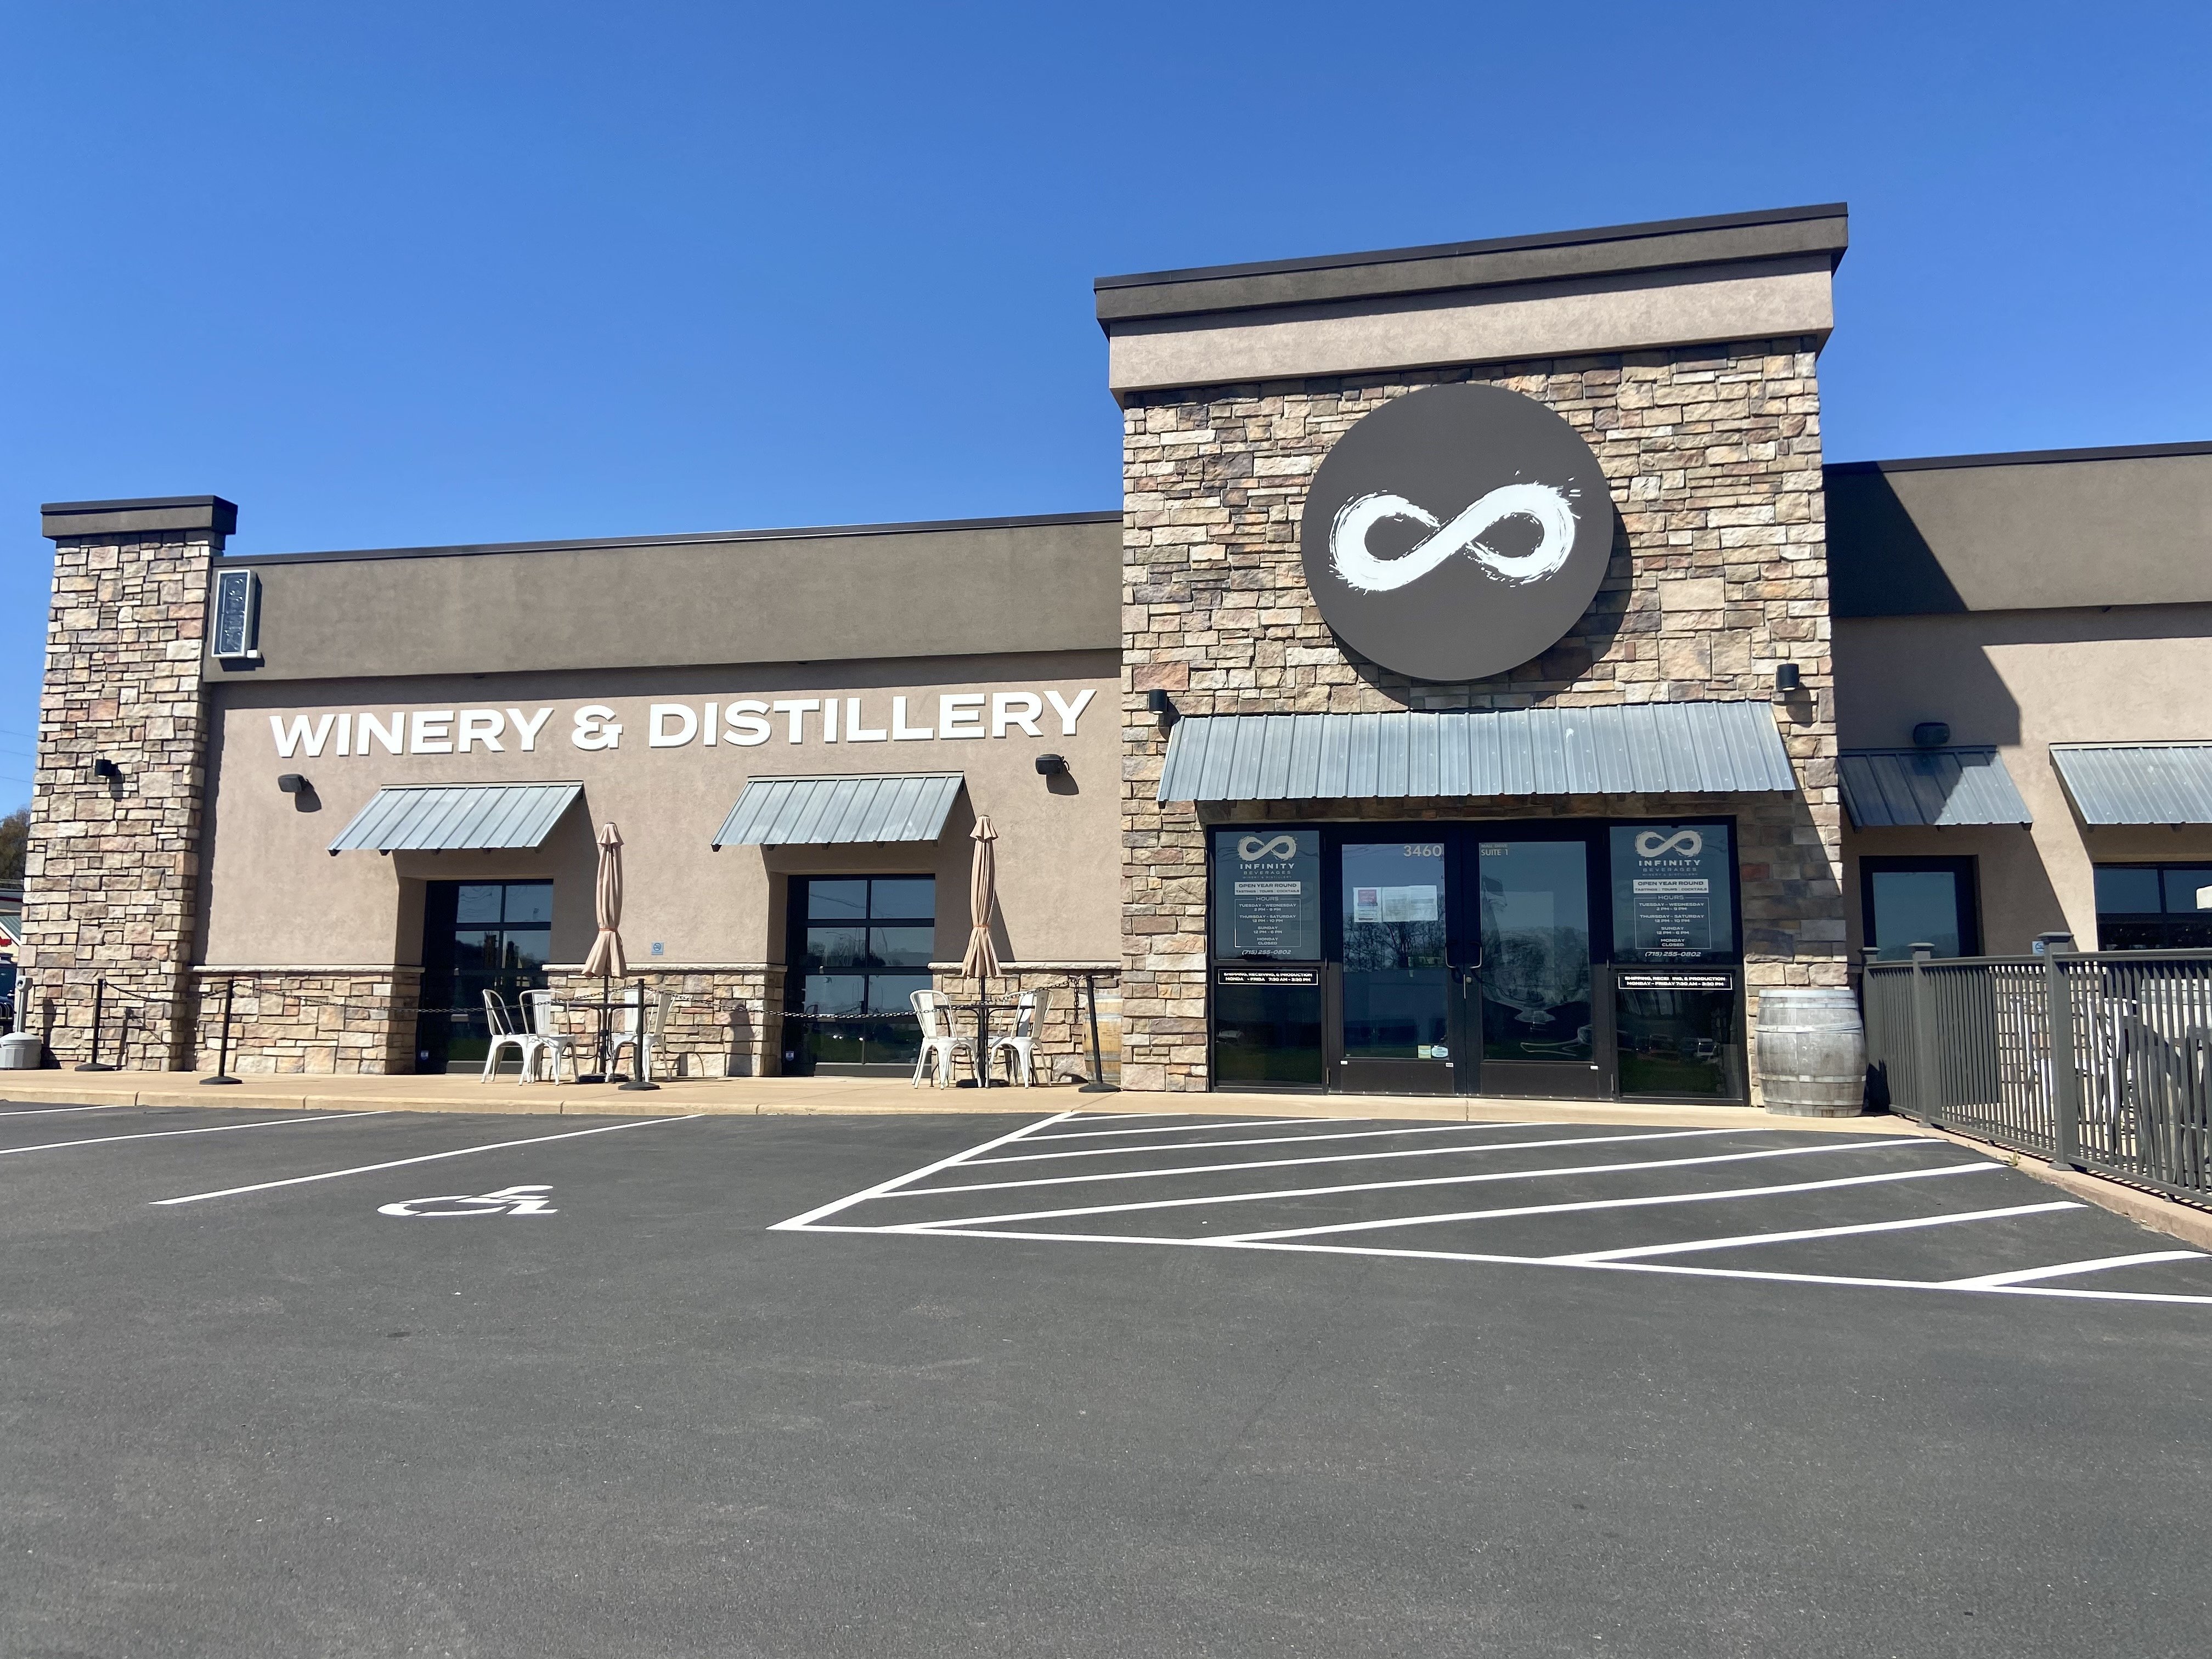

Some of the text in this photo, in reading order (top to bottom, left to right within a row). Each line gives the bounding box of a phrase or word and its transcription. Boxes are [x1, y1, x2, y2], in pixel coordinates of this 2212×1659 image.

[269, 689, 1097, 757] WINERY & DISTILLERY
[1403, 845, 1442, 857] 3460
